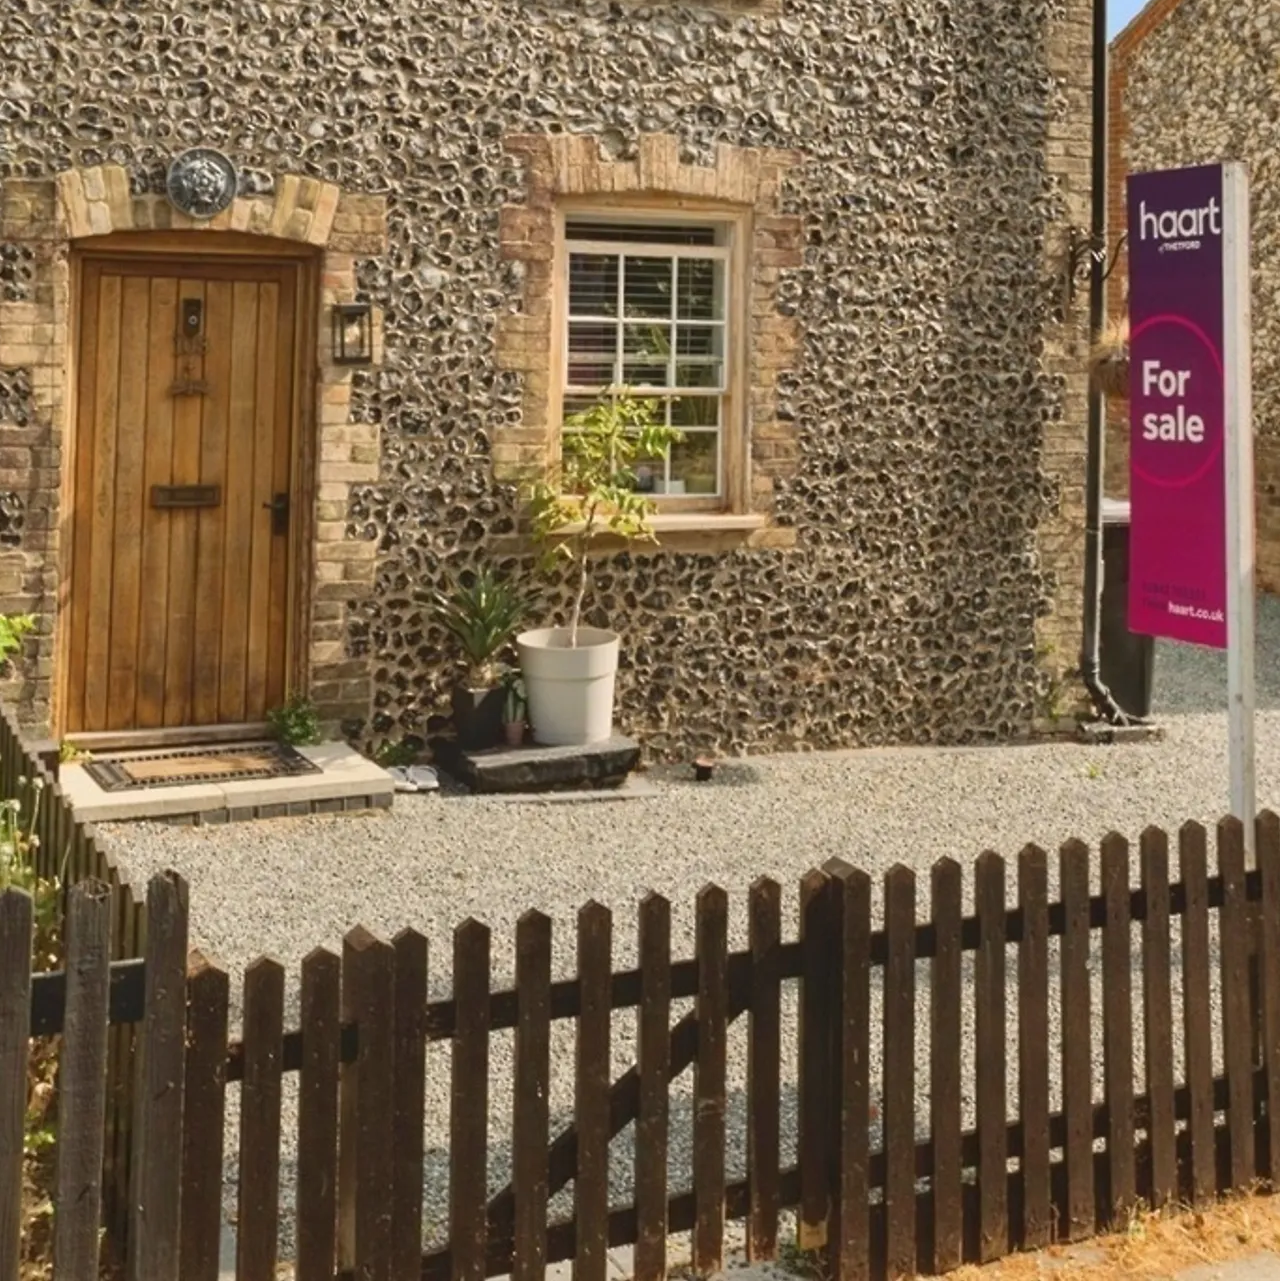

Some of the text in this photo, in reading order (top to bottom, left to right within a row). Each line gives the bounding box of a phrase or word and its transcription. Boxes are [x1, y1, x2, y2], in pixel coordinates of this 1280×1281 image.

[1140, 197, 1221, 240] haart
[1143, 360, 1191, 397] For
[1143, 404, 1204, 443] sale
[1168, 601, 1224, 622] haart.co.uk
